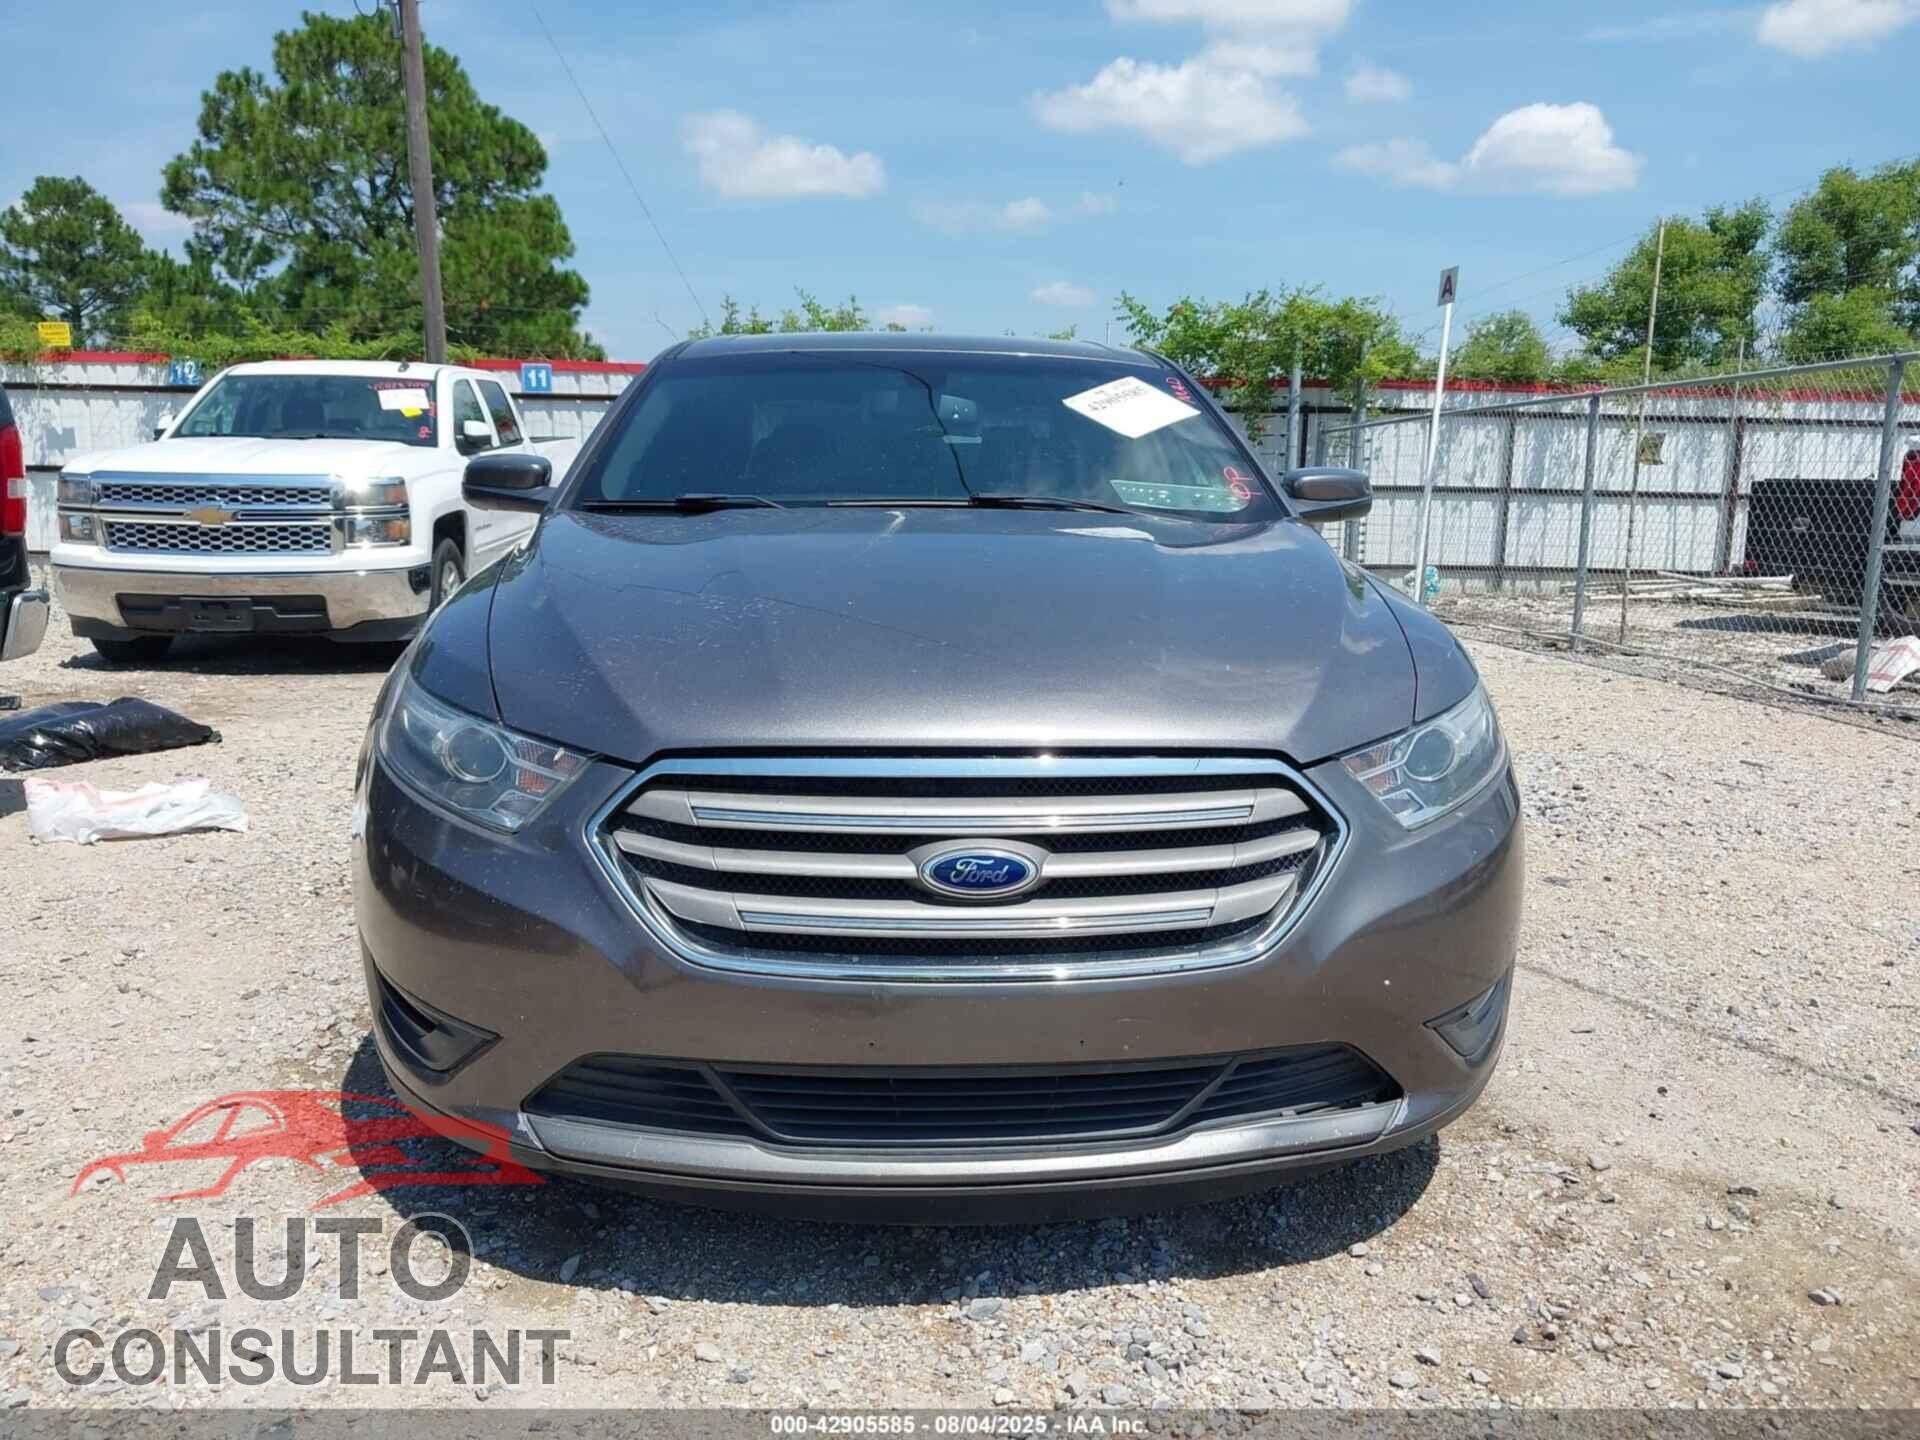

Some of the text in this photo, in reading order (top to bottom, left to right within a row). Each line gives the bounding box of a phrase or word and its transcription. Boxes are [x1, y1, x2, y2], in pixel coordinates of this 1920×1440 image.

[1440, 274, 1453, 299] A
[528, 369, 547, 388] 11
[950, 858, 1010, 884] Ford
